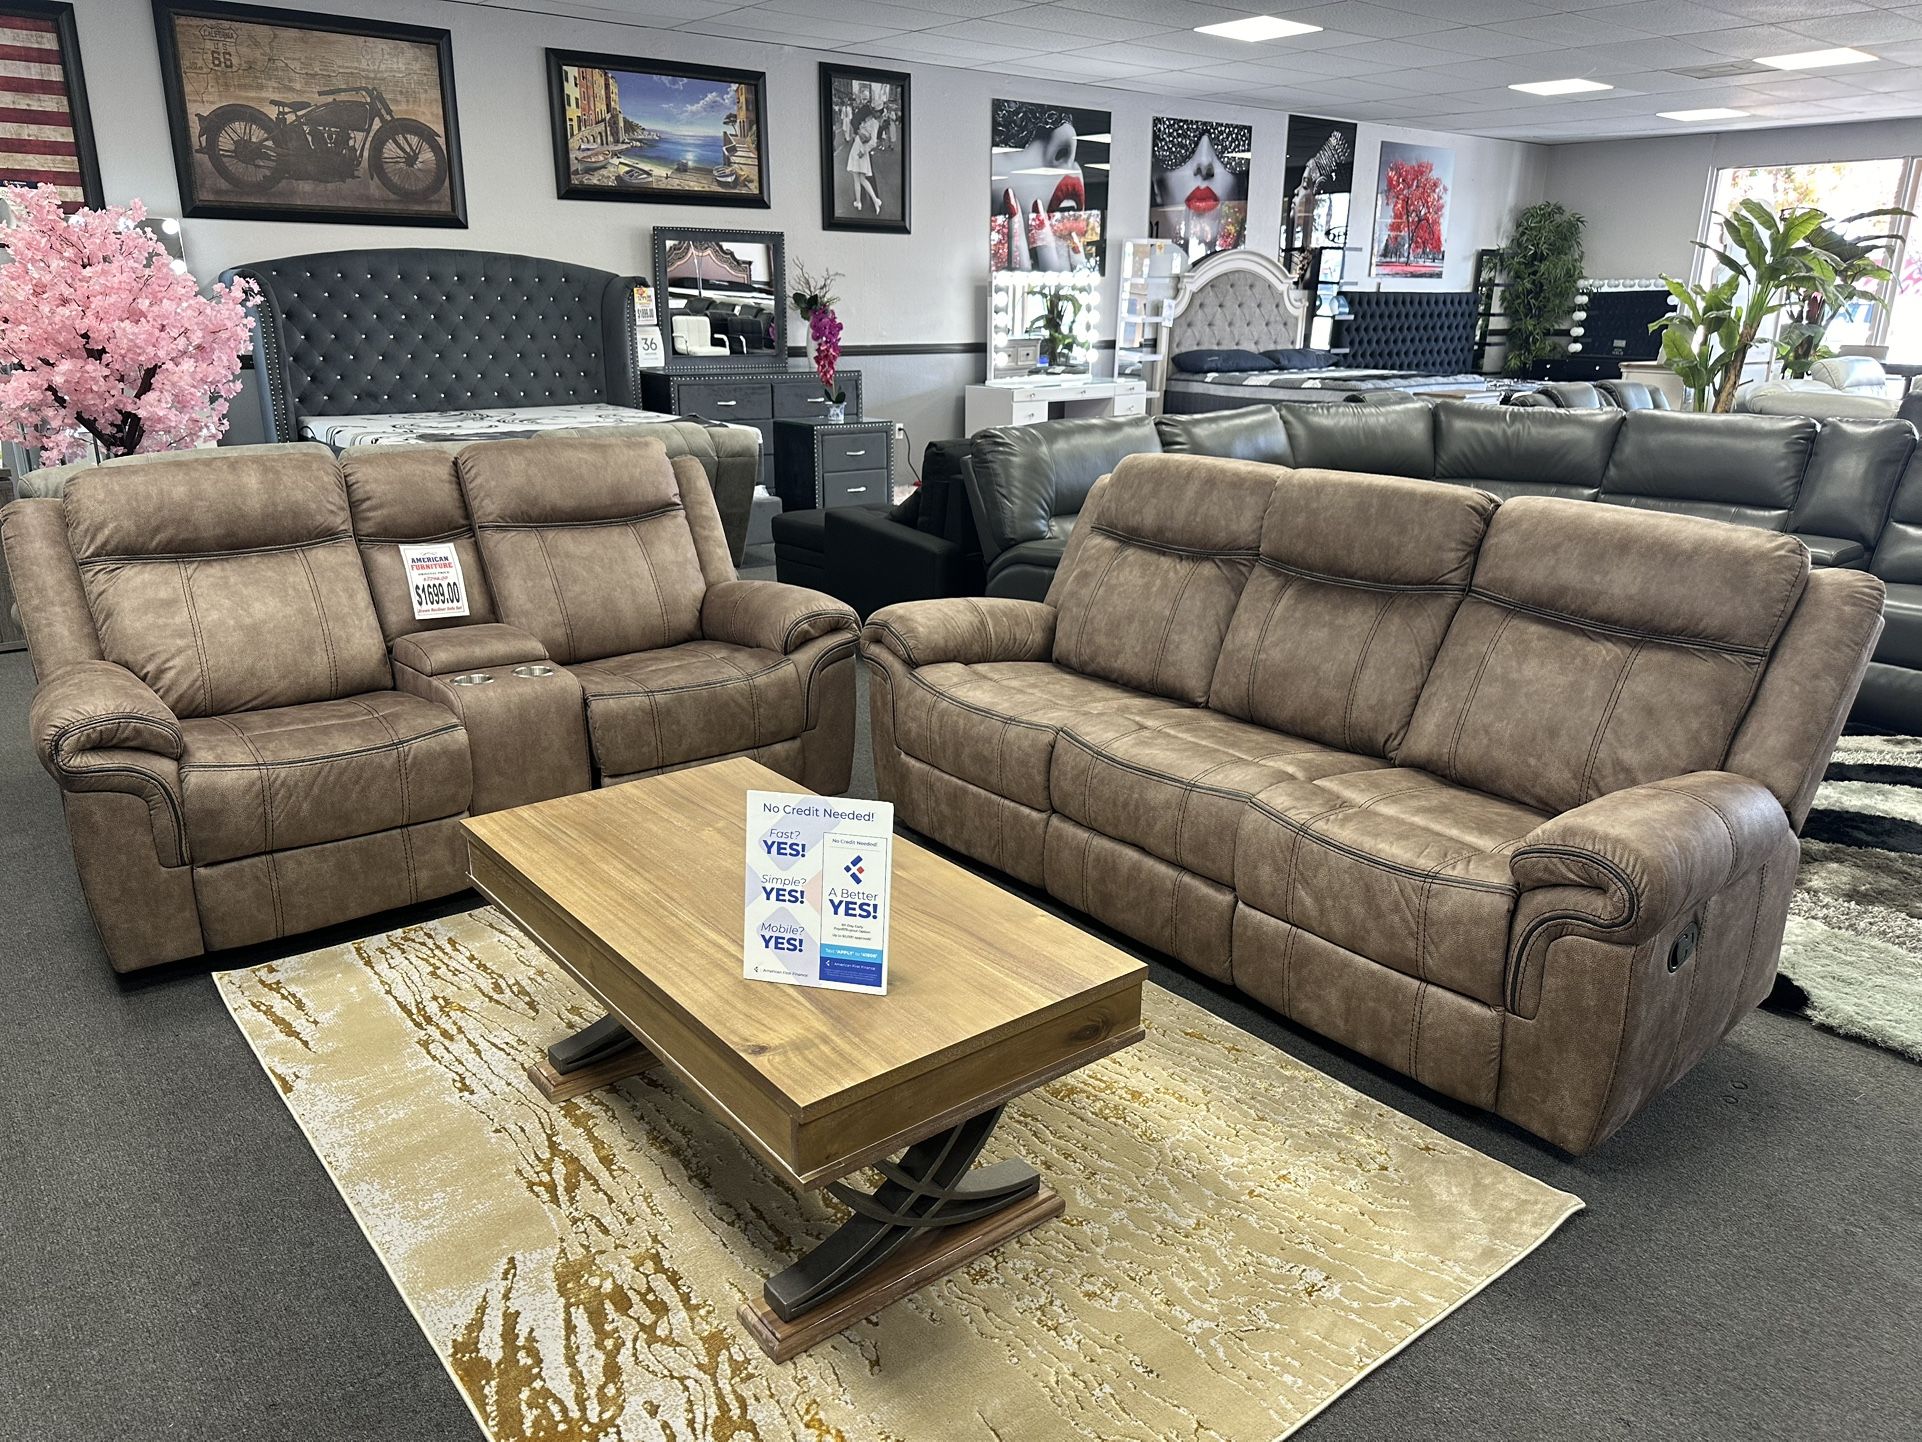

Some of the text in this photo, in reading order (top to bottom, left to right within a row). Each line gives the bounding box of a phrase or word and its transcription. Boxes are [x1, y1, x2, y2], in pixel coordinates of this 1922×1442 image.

[211, 50, 233, 68] 66
[641, 338, 657, 351] 36
[411, 562, 453, 571] FURNITURE
[415, 582, 460, 606] $1699.00
[763, 803, 874, 822] No Credit Needed!
[769, 828, 801, 840] Fast?
[763, 840, 807, 858] YES!
[761, 874, 806, 887] Simple?
[762, 886, 805, 904] YES!
[828, 887, 878, 902] A Better
[829, 899, 878, 920] YES!
[761, 922, 805, 936] Mobile?
[760, 934, 804, 953] YES!
